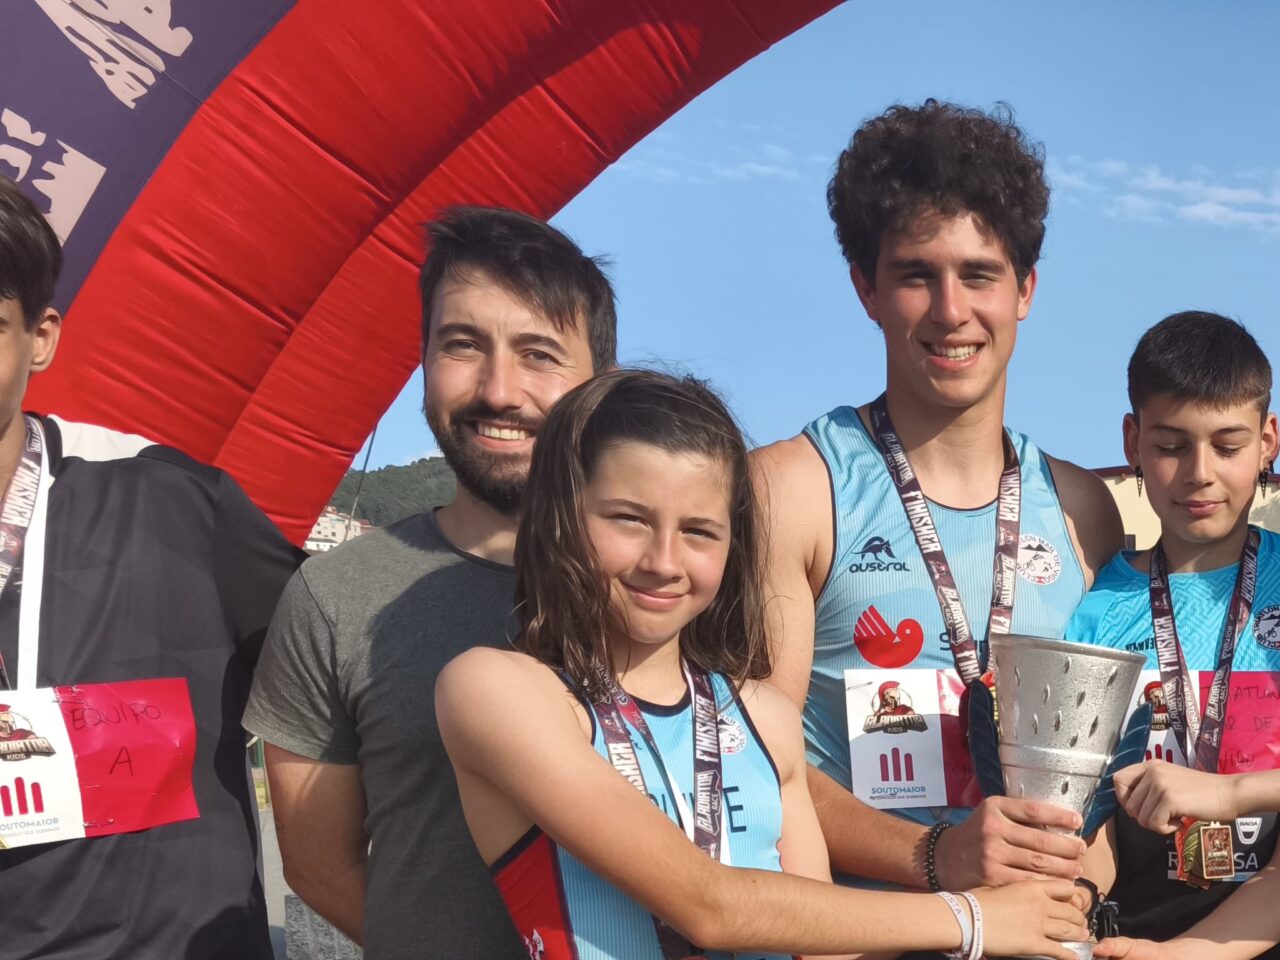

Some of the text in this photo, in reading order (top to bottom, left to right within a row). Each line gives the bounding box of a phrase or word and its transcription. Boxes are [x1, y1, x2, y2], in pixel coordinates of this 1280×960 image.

[902, 490, 942, 553] FINISHER
[942, 586, 970, 644] GLADIATOR
[1154, 615, 1179, 672] FINISHER
[71, 703, 162, 731] EQUIPO
[695, 694, 718, 763] FINISHER
[6, 752, 26, 761] KIDS
[109, 746, 134, 776] A
[696, 770, 714, 832] GLADIATOR
[871, 786, 926, 795] SOUTOMAIOR
[0, 817, 60, 831] OUTOMAIOR
